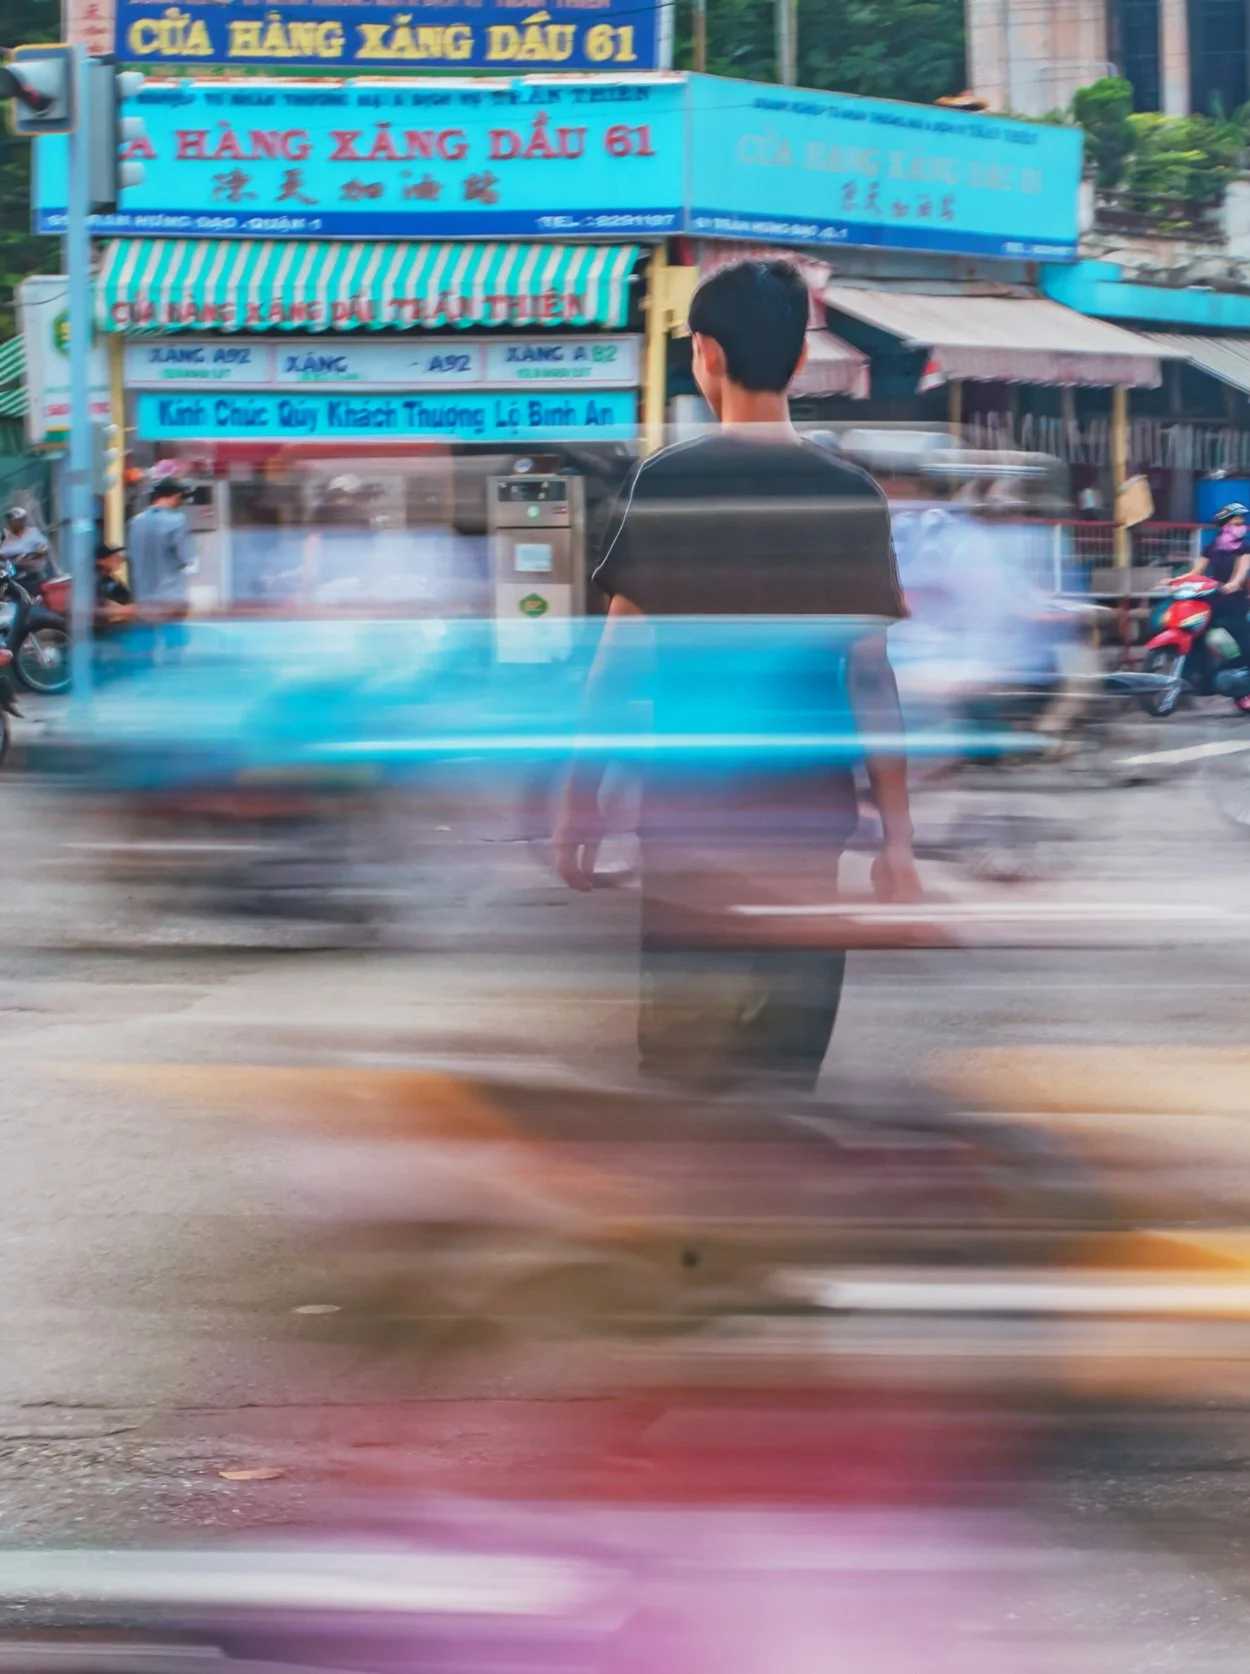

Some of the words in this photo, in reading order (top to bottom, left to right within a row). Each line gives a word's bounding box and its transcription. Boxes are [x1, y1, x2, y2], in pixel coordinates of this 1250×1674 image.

[228, 10, 345, 57] HÀNG
[584, 23, 637, 61] 61
[174, 119, 313, 161] HÀNG
[329, 120, 470, 161] XĂNG
[604, 124, 656, 157] 61
[427, 354, 472, 372] A92
